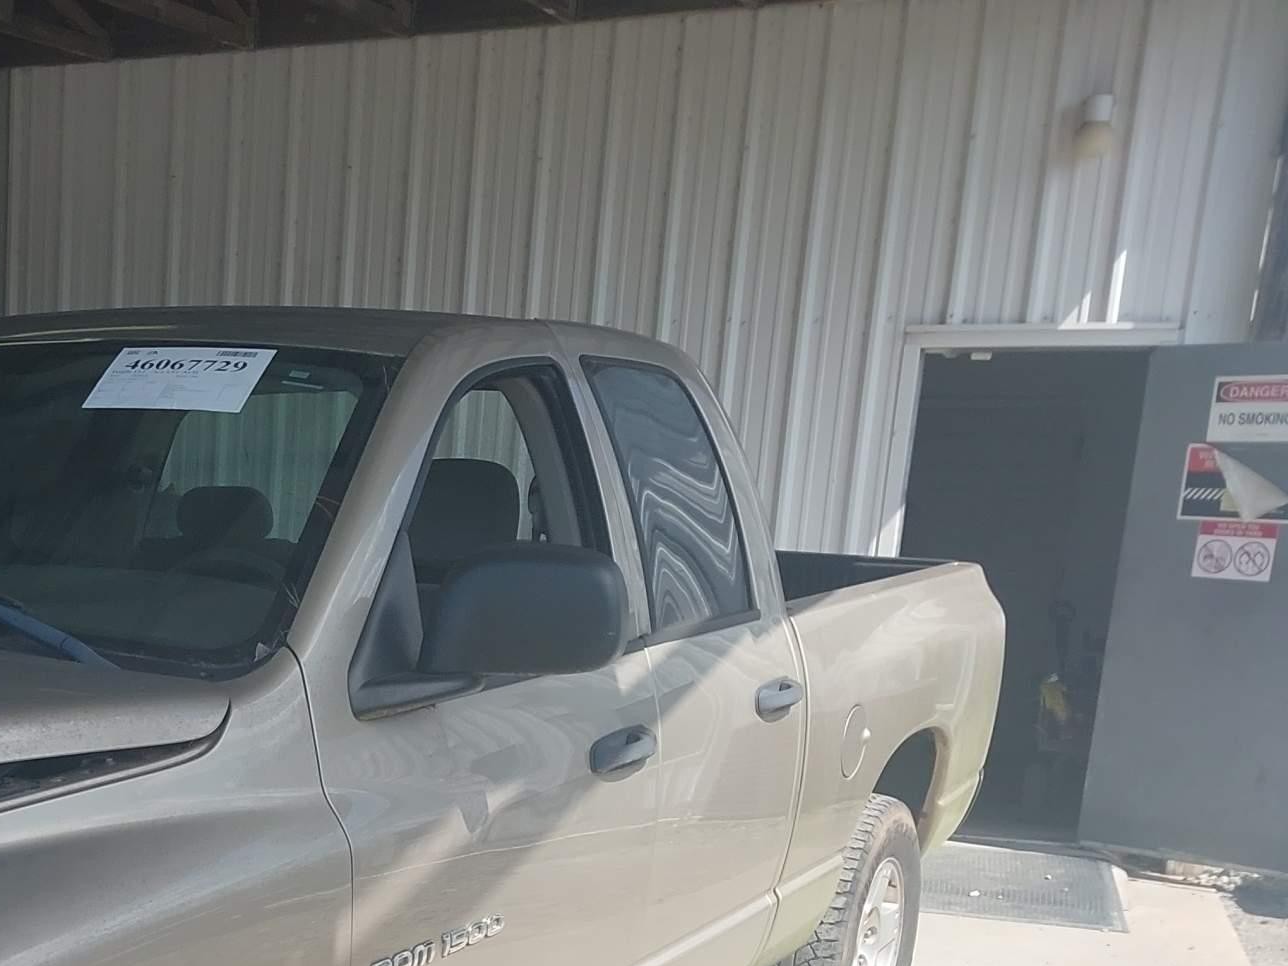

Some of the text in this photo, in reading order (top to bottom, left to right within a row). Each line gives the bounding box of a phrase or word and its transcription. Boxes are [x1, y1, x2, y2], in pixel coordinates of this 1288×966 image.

[124, 358, 249, 374] 46067729
[1230, 385, 1288, 398] DANGER
[1218, 411, 1236, 426] NO
[440, 913, 505, 958] 1500
